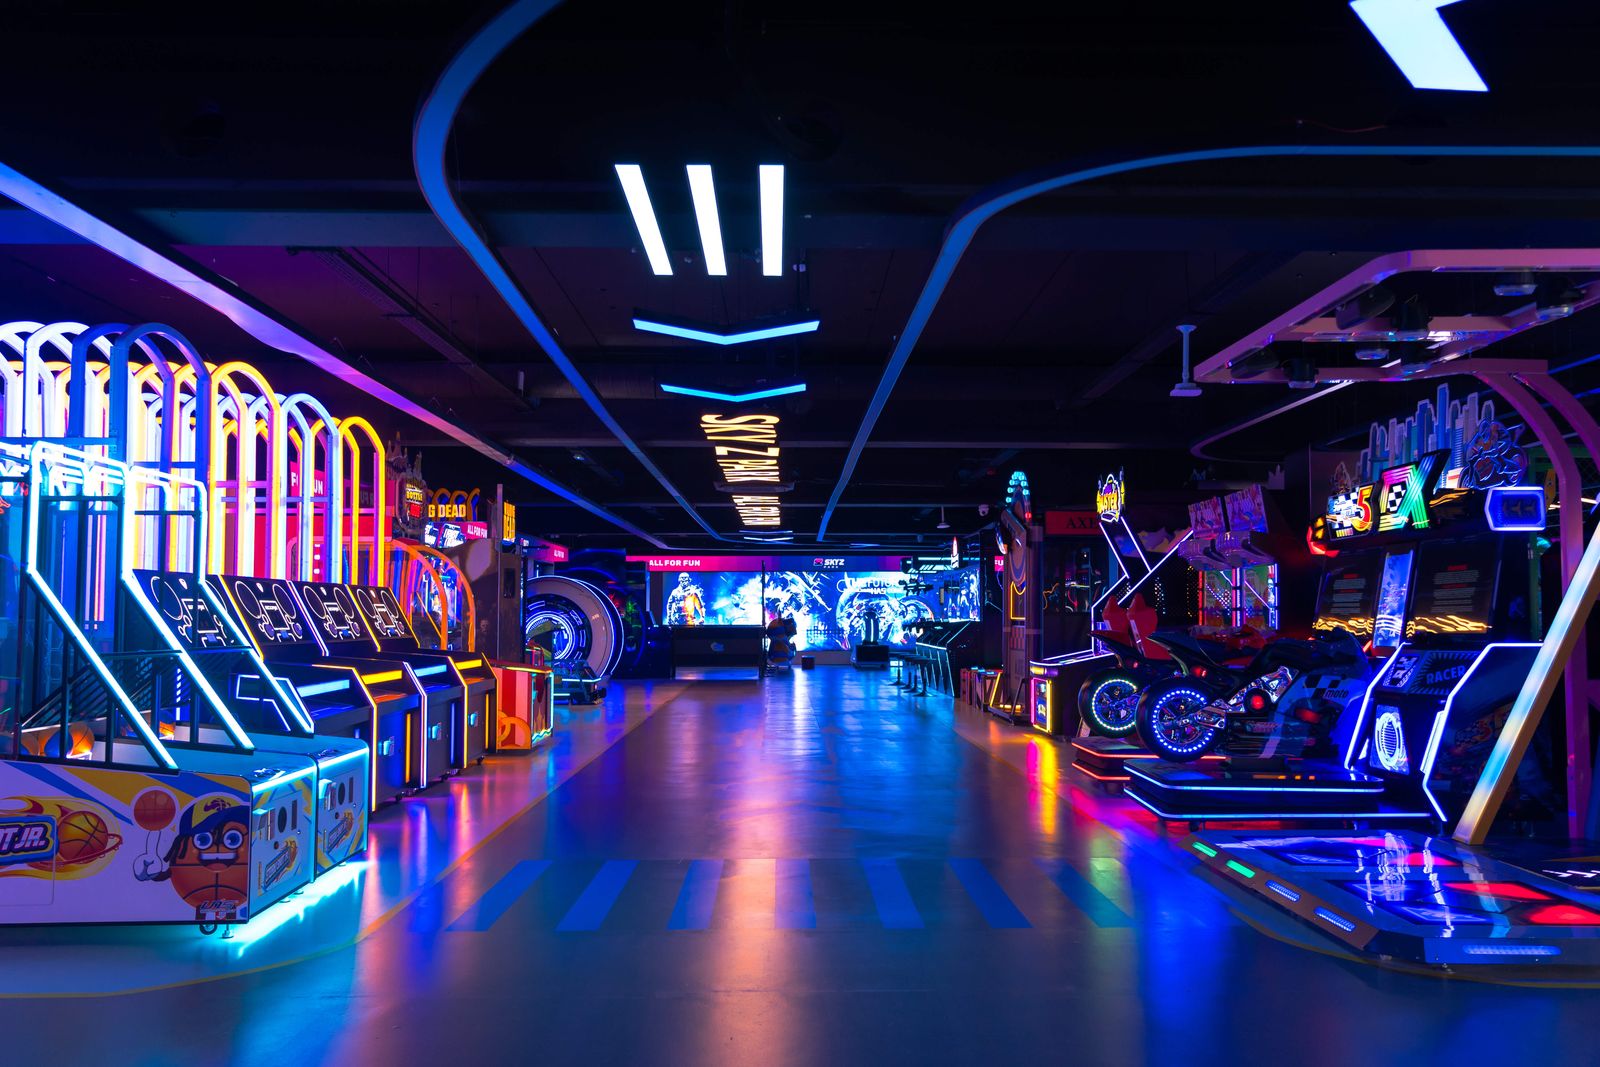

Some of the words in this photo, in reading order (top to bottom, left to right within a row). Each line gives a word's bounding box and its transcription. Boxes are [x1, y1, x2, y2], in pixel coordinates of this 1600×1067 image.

[700, 414, 780, 457] SKYZ
[716, 459, 781, 482] PARK
[428, 504, 436, 518] G
[438, 504, 467, 518] DEAD
[1351, 485, 1374, 531] 5
[649, 559, 663, 567] ALL
[664, 559, 682, 567] FOR
[682, 559, 701, 567] FUN
[824, 558, 845, 566] SKYZ
[1426, 665, 1467, 685] RACER
[1324, 688, 1350, 699] moto
[14, 826, 46, 849] JR.
